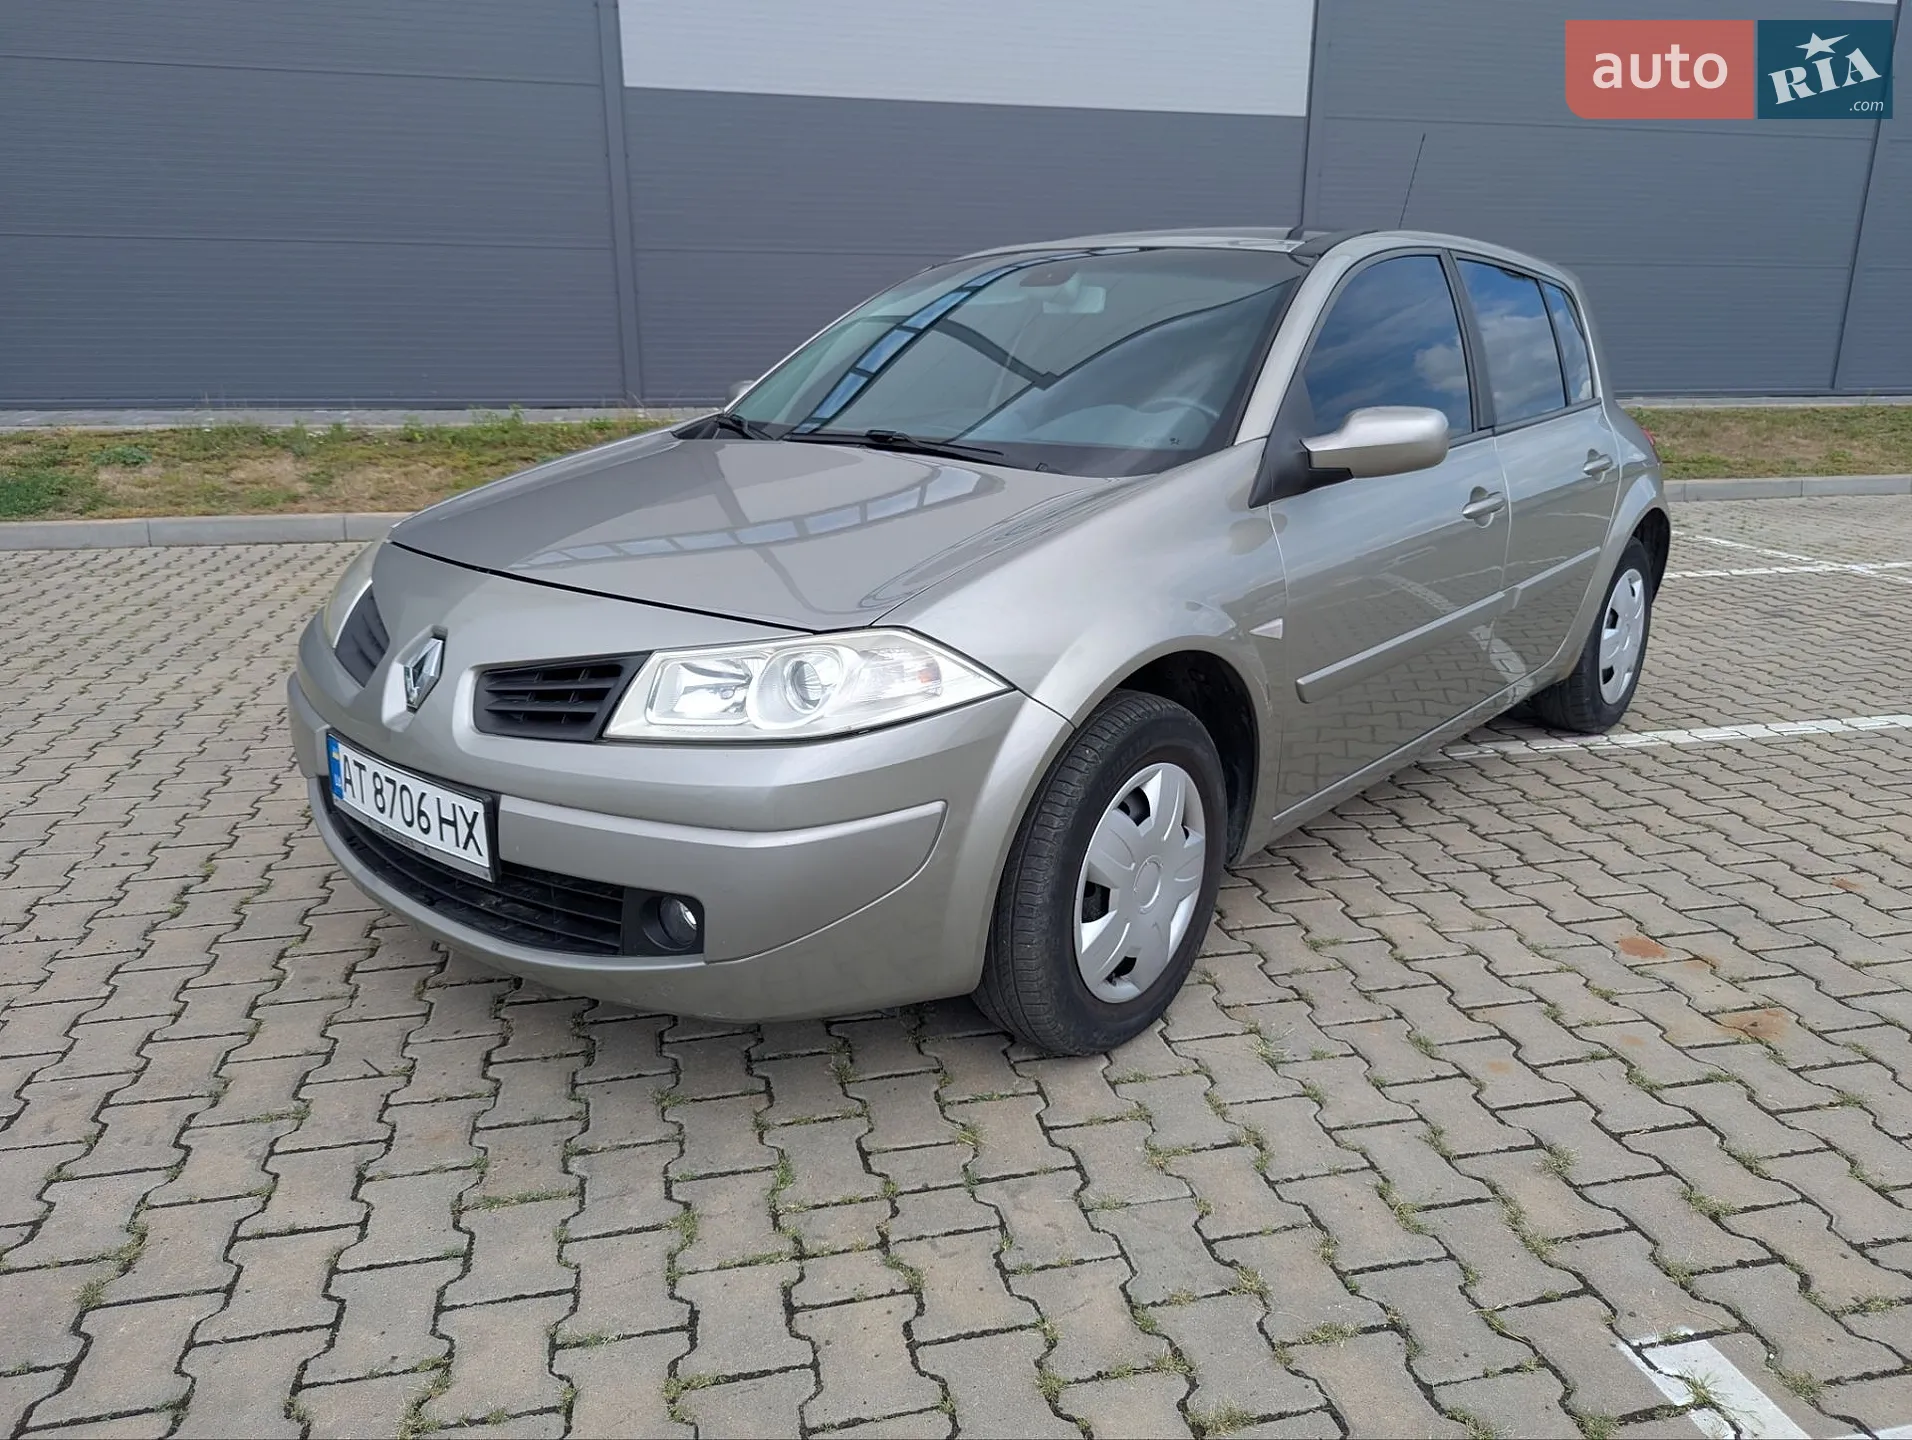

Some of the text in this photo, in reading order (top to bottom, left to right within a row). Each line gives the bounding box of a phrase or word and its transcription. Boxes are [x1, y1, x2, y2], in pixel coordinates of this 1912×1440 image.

[343, 754, 367, 805] AT
[372, 771, 431, 835] 8706
[436, 797, 484, 857] HX
